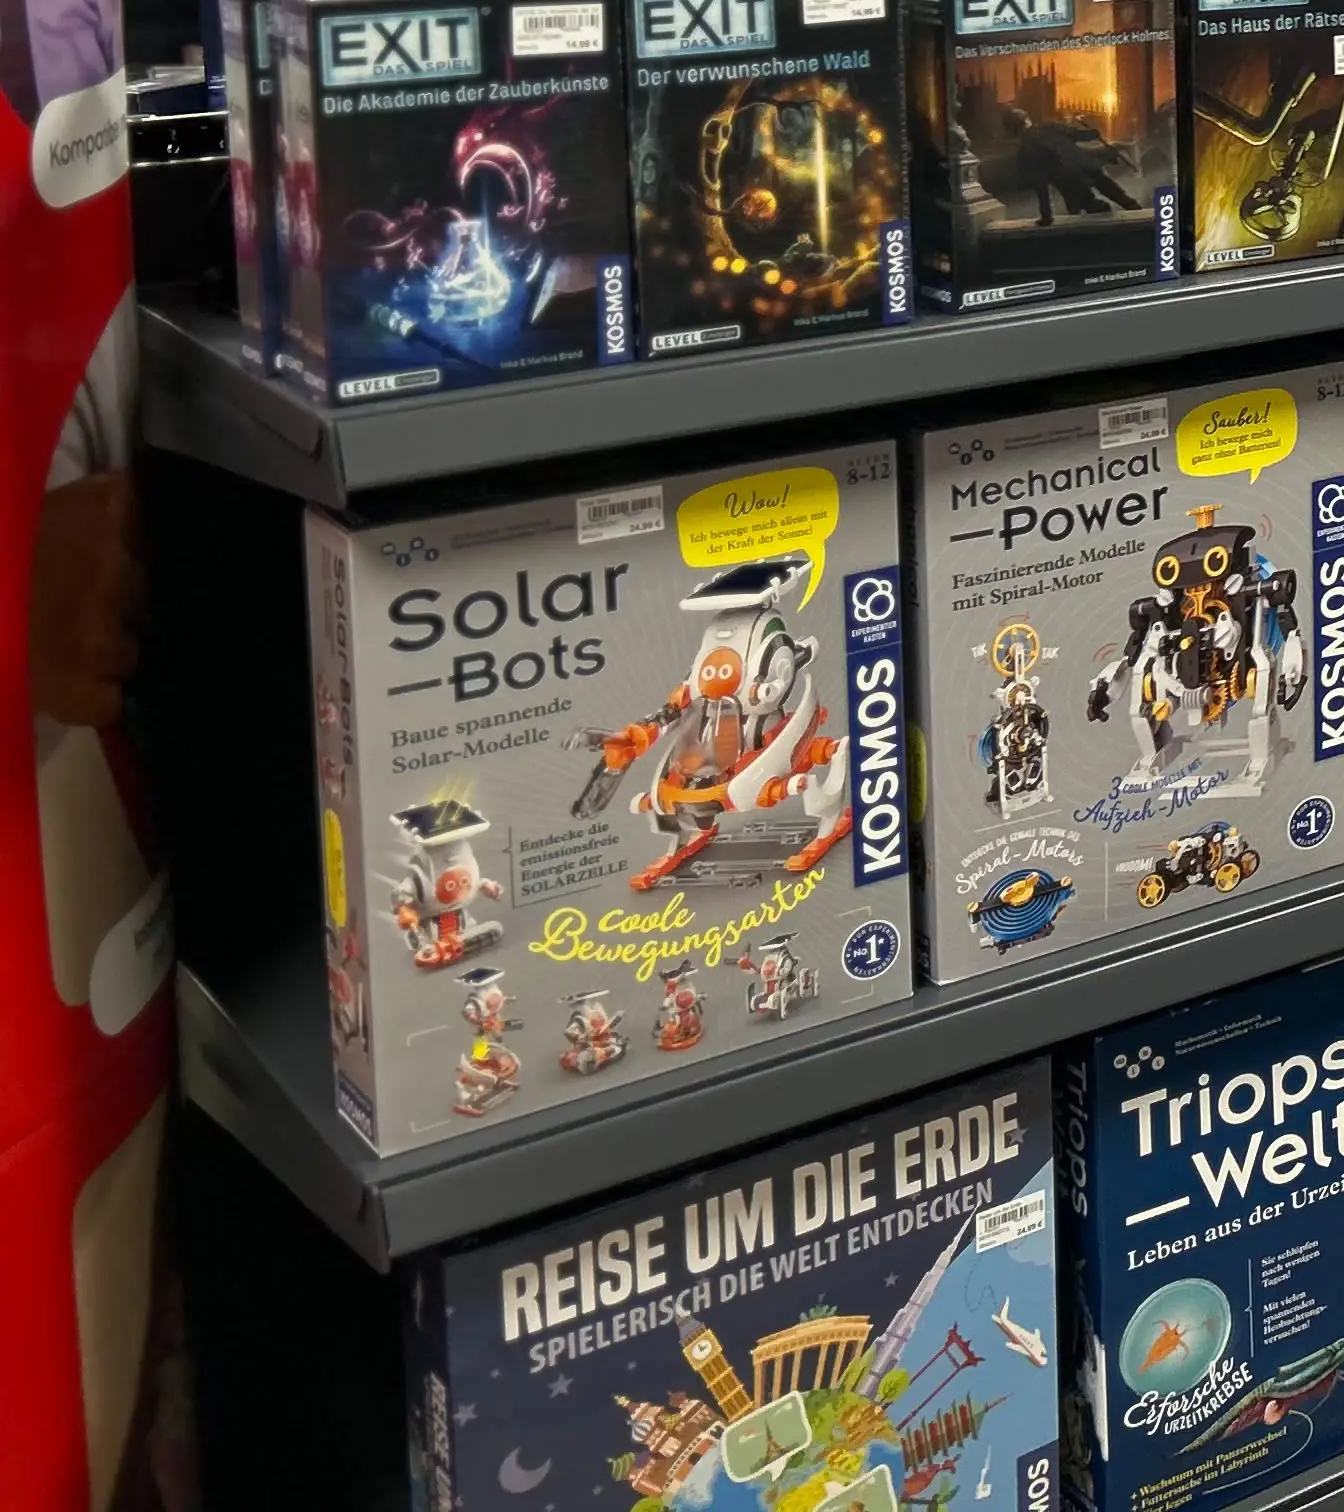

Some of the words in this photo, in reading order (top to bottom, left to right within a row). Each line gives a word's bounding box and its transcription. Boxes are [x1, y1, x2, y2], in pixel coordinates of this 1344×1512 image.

[332, 16, 472, 74] EXIT
[1199, 20, 1227, 37] Das
[1231, 18, 1270, 34] Haus
[1274, 15, 1301, 32] der
[638, 67, 669, 88] Der
[676, 57, 818, 84] verwunschene
[824, 49, 870, 70] Wald
[324, 97, 352, 115] Die
[358, 88, 450, 111] Akademie
[456, 85, 485, 103] der
[490, 75, 608, 99] Zauberkünste
[1203, 402, 1272, 435] Sauber!
[847, 463, 891, 485] 8-12
[951, 447, 1161, 511] Mechanical
[724, 484, 790, 518] Wow!
[952, 553, 1076, 591] Faszinierende
[1078, 538, 1145, 566] Modelle
[387, 561, 631, 653] Solar
[952, 592, 986, 612] mit
[989, 569, 1104, 606] Spiral-Motor
[391, 723, 450, 750] Baue
[455, 696, 573, 741] spannende
[392, 725, 551, 775] Solar-Modelle
[857, 658, 901, 874] KOSMOS
[520, 830, 584, 852] Entdecke
[588, 823, 609, 834] die
[520, 835, 619, 867] emissionsfreie
[522, 860, 575, 882] Energie
[579, 854, 602, 866] der
[522, 860, 628, 896] SOLARZELLE
[528, 867, 825, 983] Bewegungsarten
[502, 1216, 667, 1344] REISE
[684, 1177, 775, 1275] UM
[794, 1140, 877, 1238] DIE
[893, 1091, 1021, 1200] ERDE
[1127, 1229, 1199, 1272] Leben
[1204, 1216, 1242, 1244] aus
[1249, 1201, 1285, 1232] der
[528, 1278, 712, 1375] SPIELERISCH
[719, 1257, 765, 1303] DIE
[770, 1232, 839, 1281] WELT
[847, 1177, 994, 1258] ENTDECKEN
[1164, 1361, 1253, 1434] URZEITKREBSE
